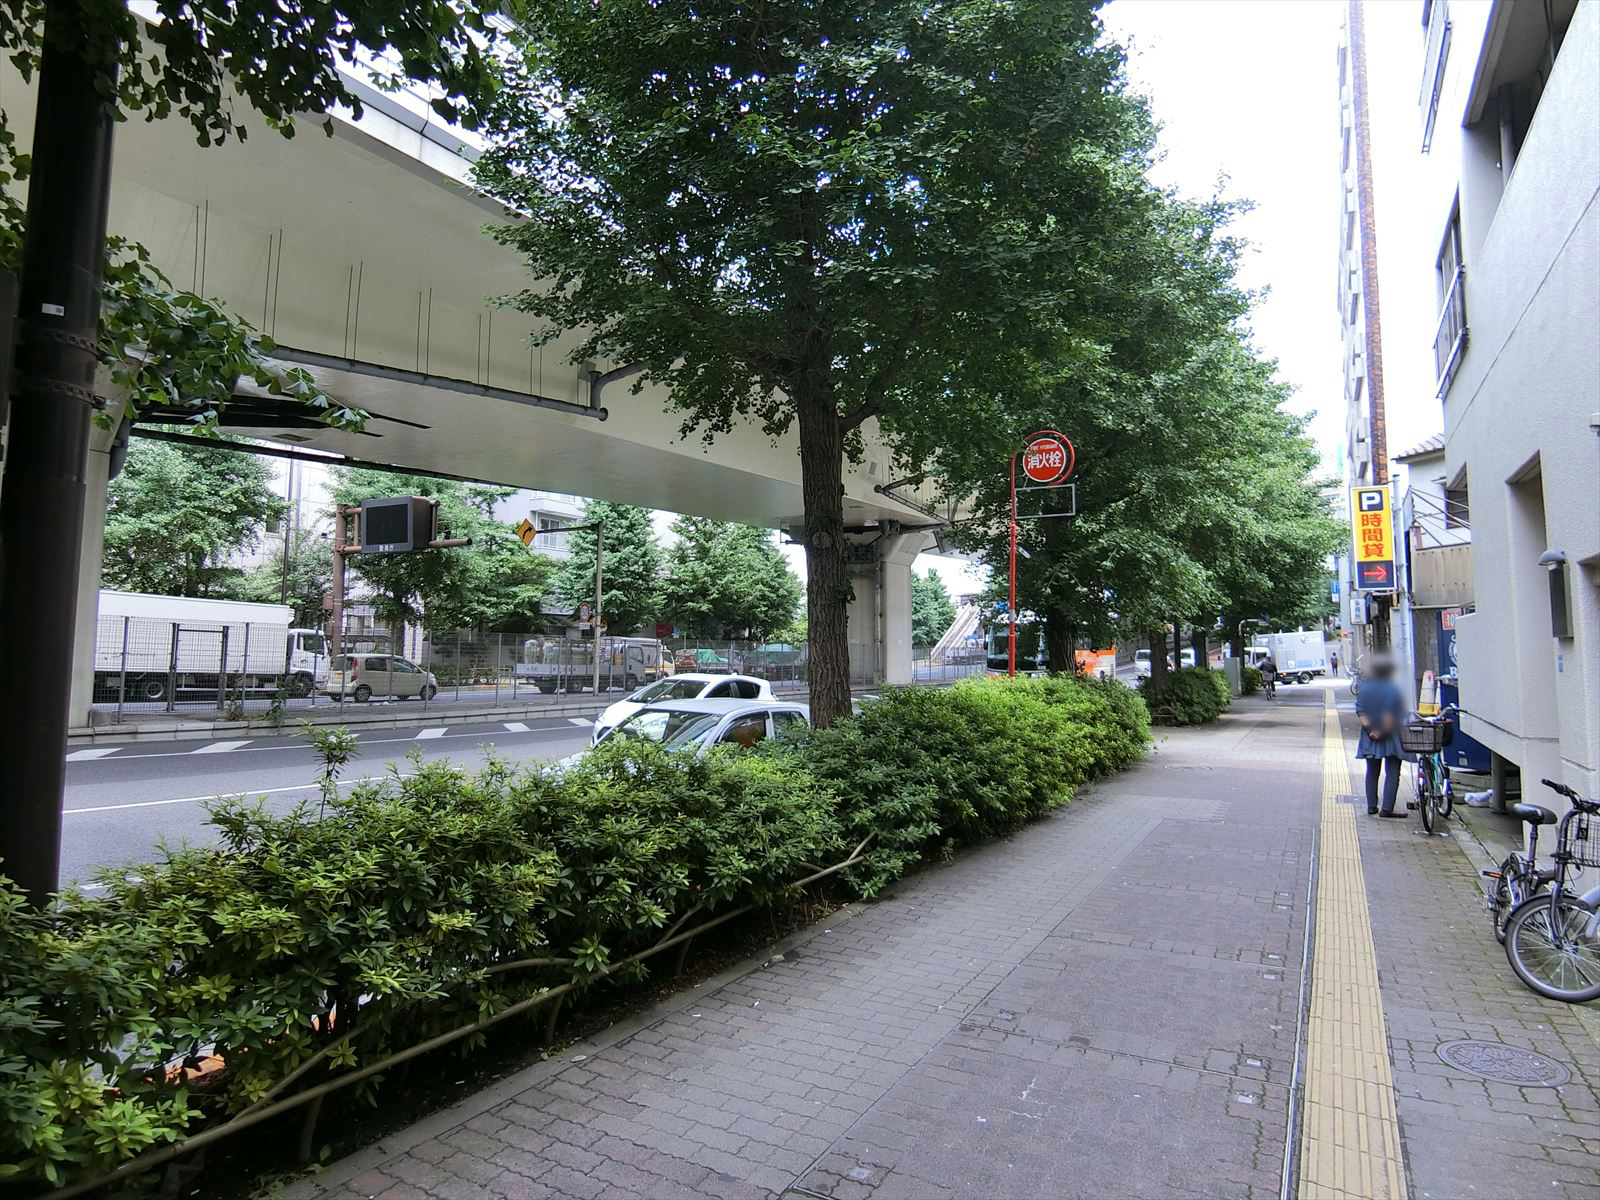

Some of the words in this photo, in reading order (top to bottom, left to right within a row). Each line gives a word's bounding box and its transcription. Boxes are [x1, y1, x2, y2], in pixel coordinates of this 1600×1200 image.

[1027, 450, 1062, 470] 消火栓
[1361, 492, 1381, 511] P
[1361, 513, 1384, 558] 時間貸
